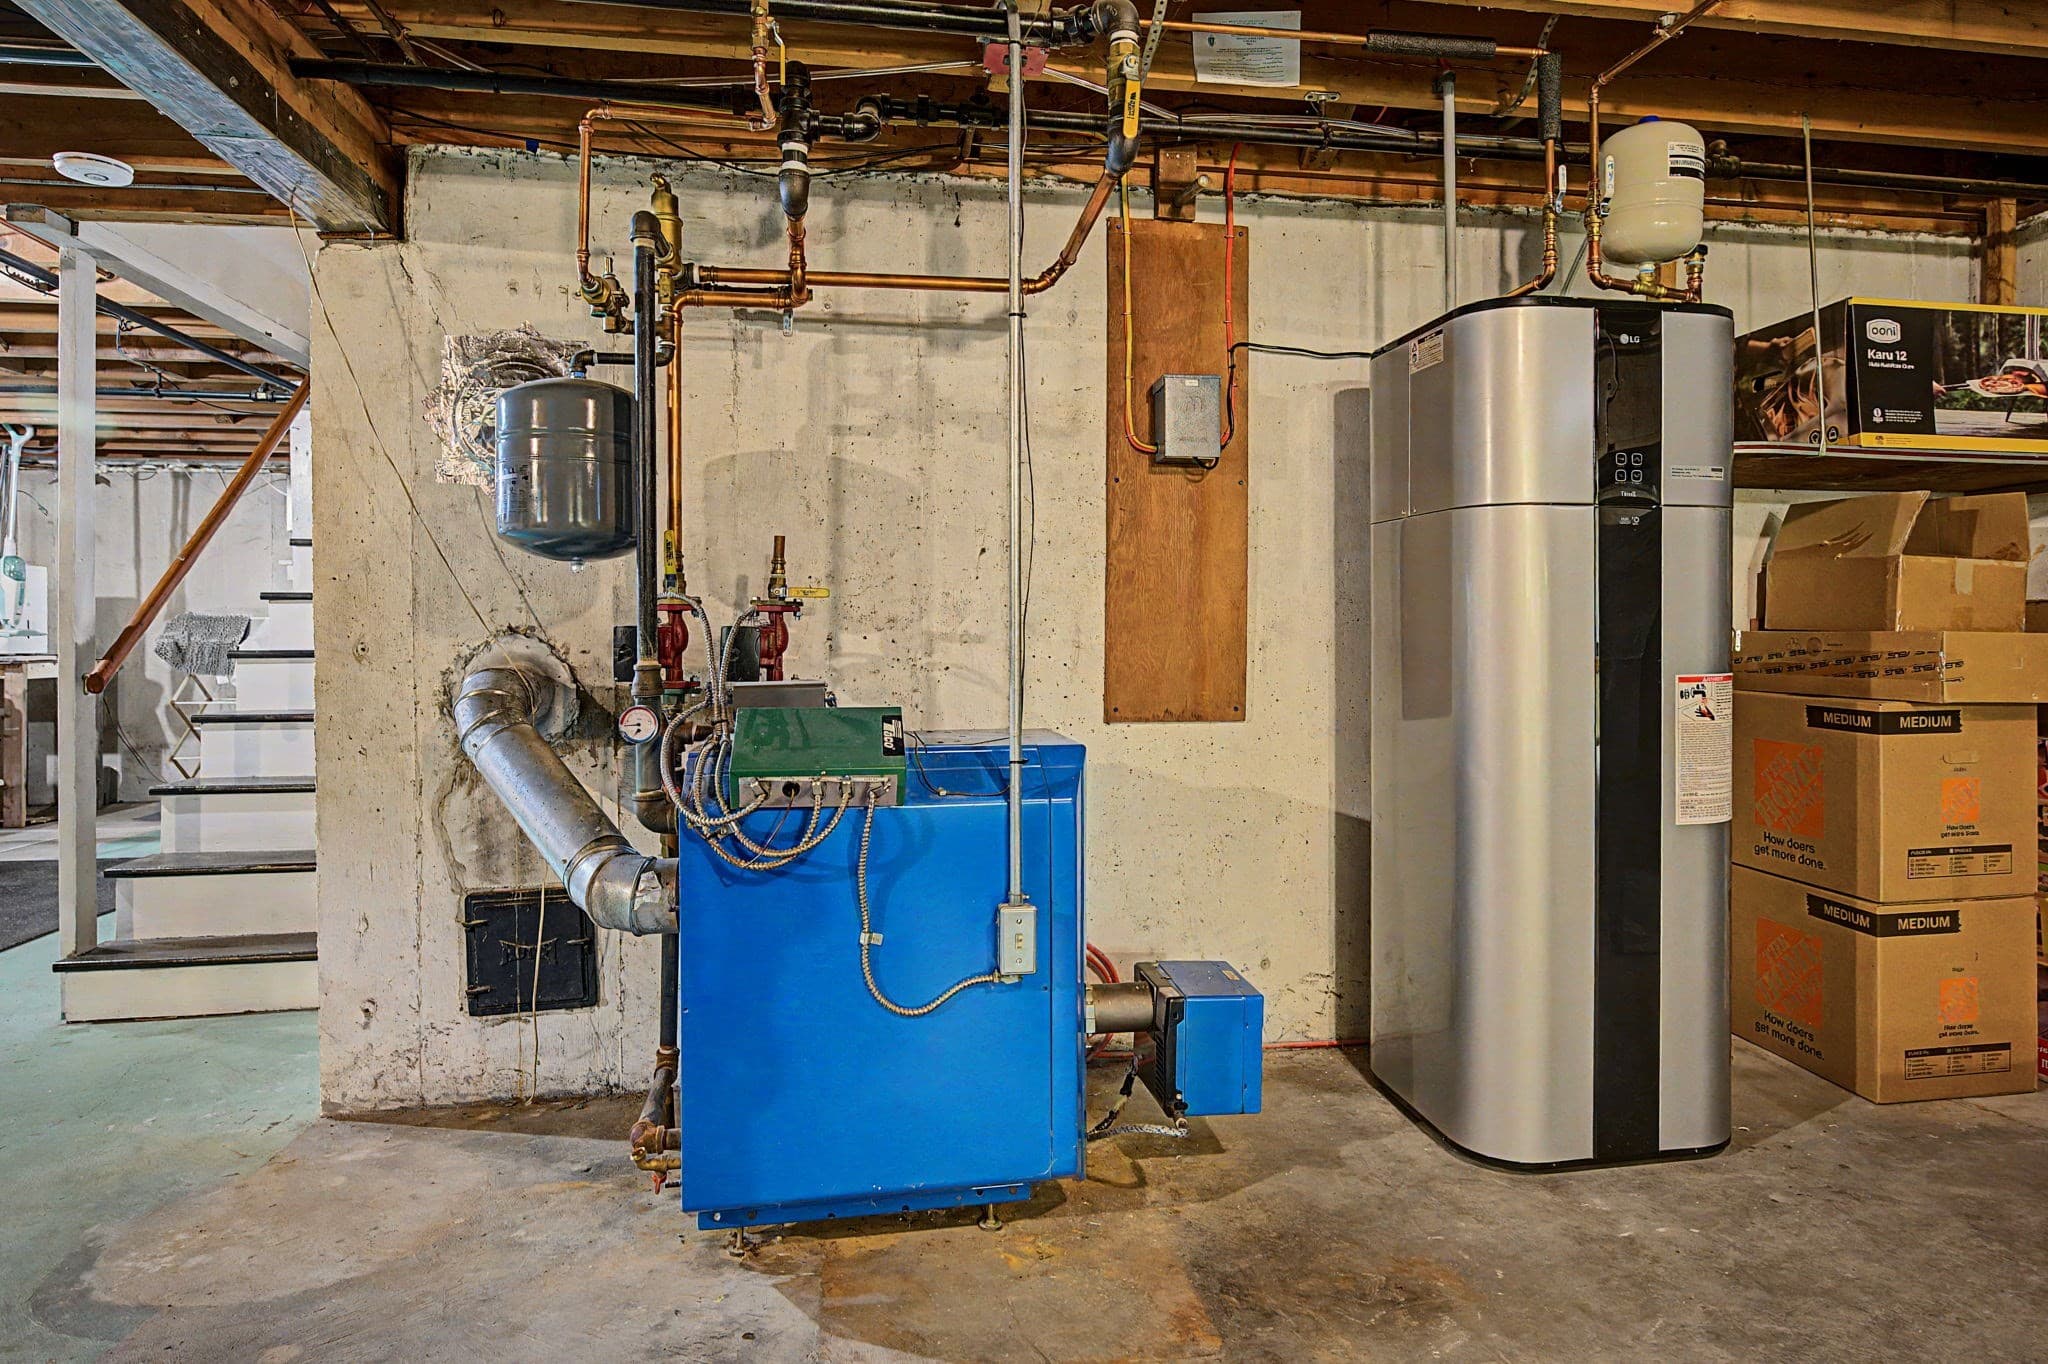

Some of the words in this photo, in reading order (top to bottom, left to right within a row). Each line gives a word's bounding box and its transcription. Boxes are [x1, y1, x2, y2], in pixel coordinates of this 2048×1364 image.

[1629, 335, 1641, 343] LG
[1871, 325, 1897, 337] ooni
[1867, 349, 1894, 361] Karu
[1895, 350, 1908, 361] 12
[1823, 712, 1872, 728] MEDIUM
[1899, 715, 1952, 729] MEDIUM
[1763, 831, 1785, 845] How
[1787, 838, 1816, 854] doers
[1754, 844, 1769, 856] get
[1771, 848, 1796, 862] more
[1798, 853, 1827, 870] done.
[1824, 903, 1870, 928] MEDIUM
[1897, 916, 1951, 930] MEDIUM
[1787, 1021, 1815, 1042] doers
[1771, 1028, 1796, 1046] more
[1798, 1040, 1825, 1061] done.
